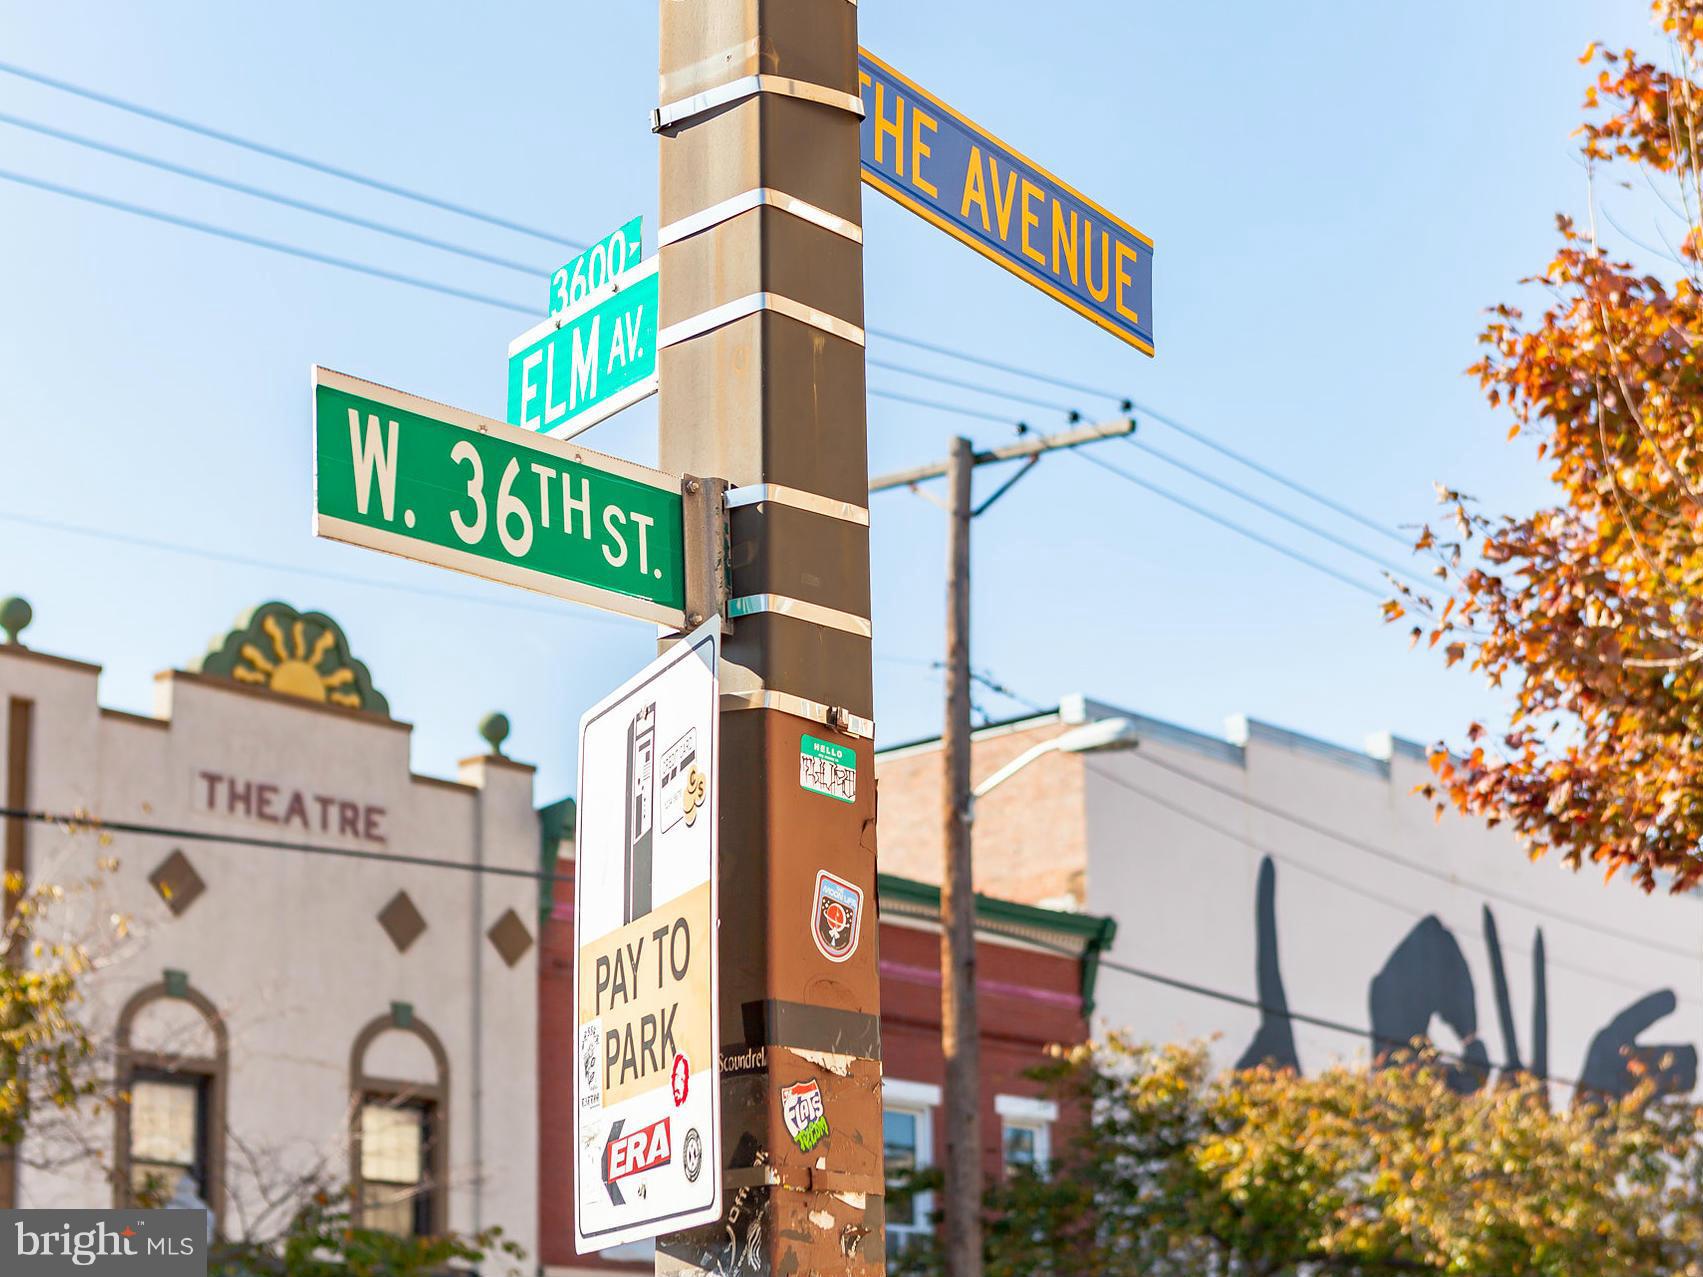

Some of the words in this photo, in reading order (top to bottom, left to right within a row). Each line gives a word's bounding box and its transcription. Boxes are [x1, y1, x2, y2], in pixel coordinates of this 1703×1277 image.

[551, 229, 626, 316] 3600
[961, 145, 1138, 324] AVENUE
[520, 315, 601, 434] ELM
[607, 305, 644, 375] AV.
[347, 407, 416, 528] W.
[450, 440, 592, 558] 36TH
[602, 504, 662, 579] ST.
[813, 742, 843, 759] HELLO
[199, 771, 387, 844] THEATRE
[596, 936, 645, 1016] PAY
[652, 917, 690, 989] TO
[606, 1002, 679, 1090] PARK
[609, 1121, 671, 1181] ERA
